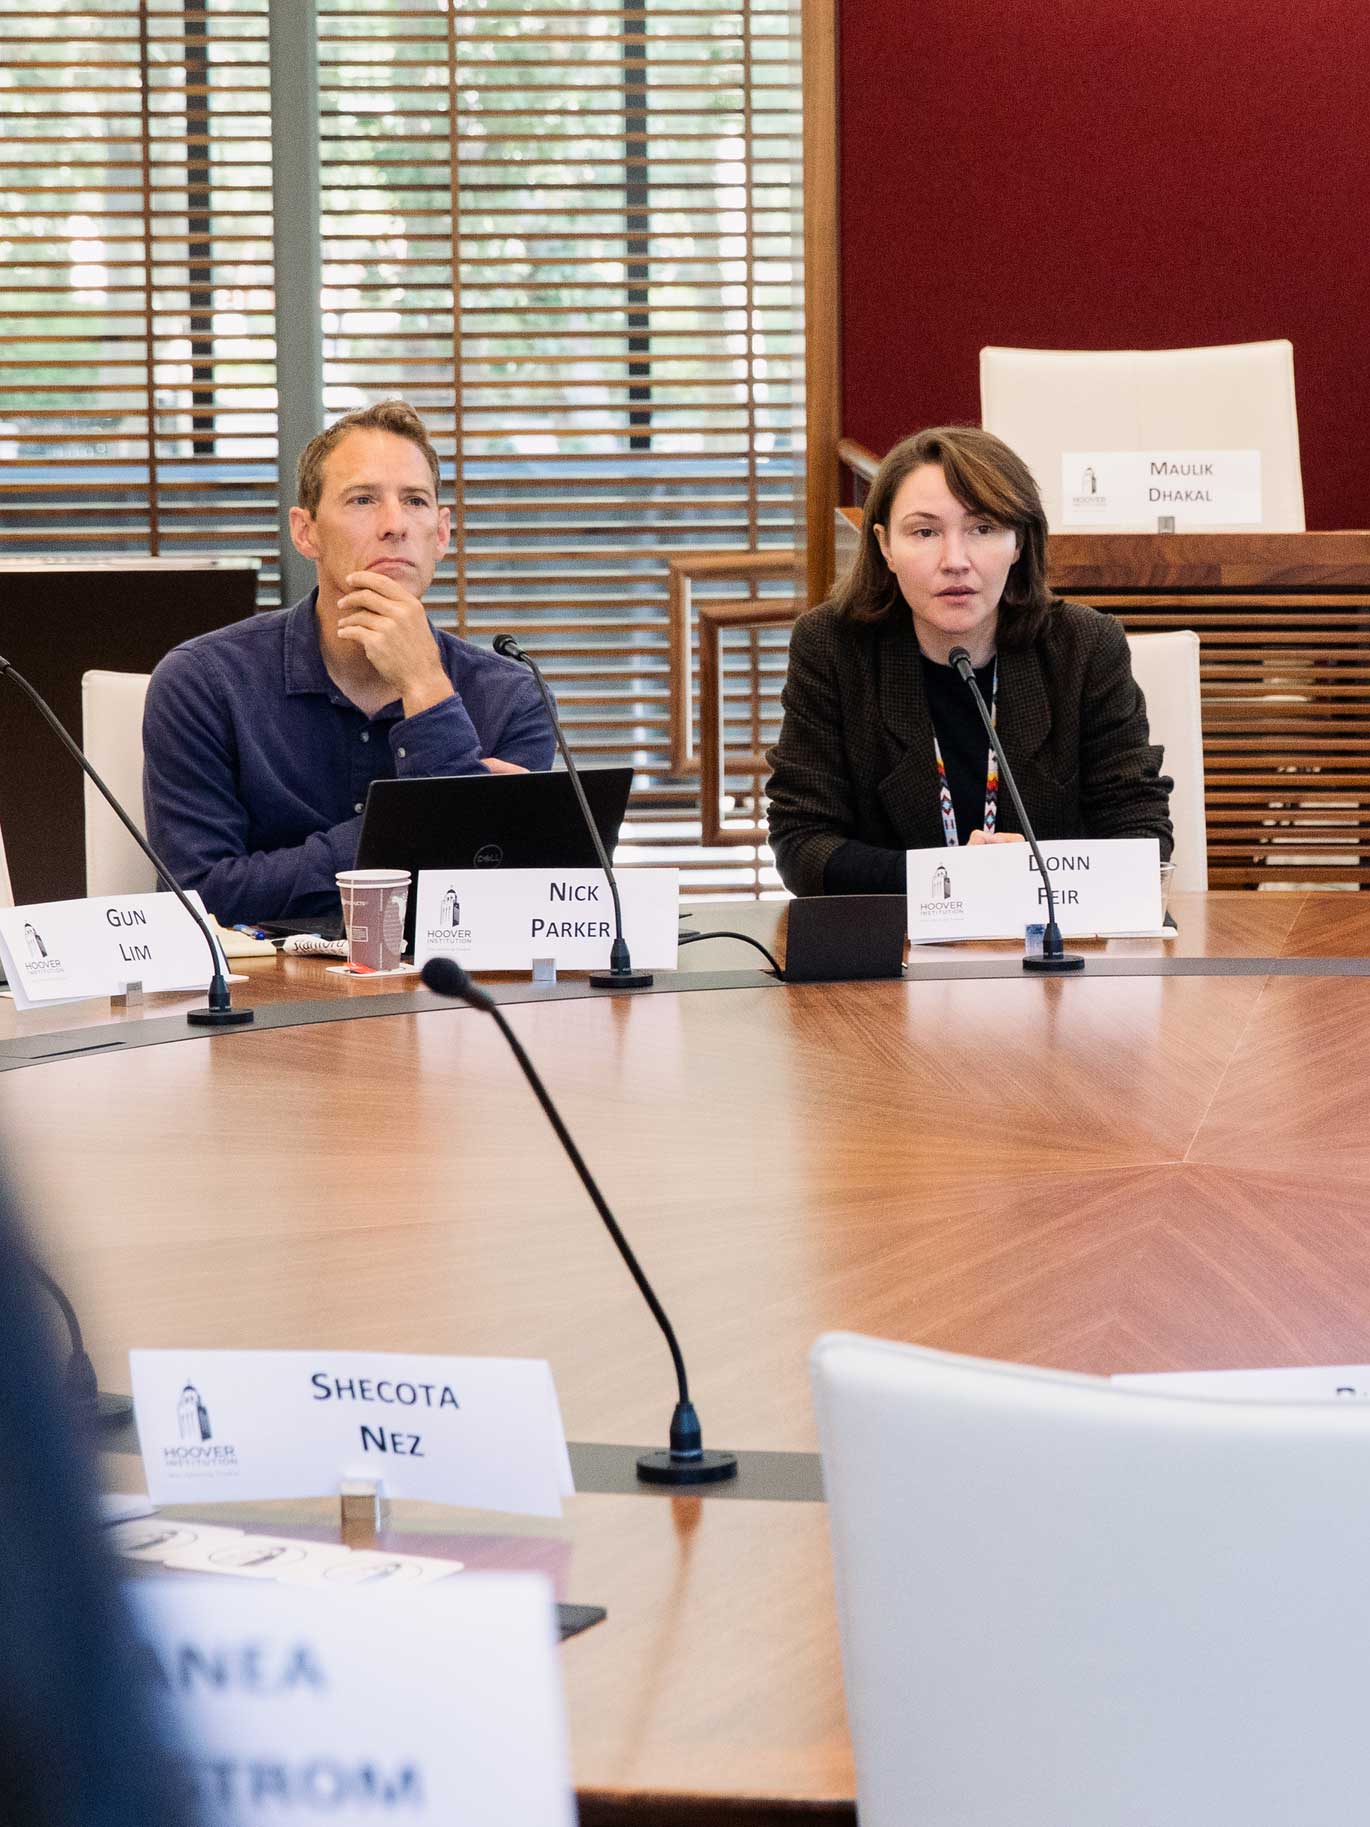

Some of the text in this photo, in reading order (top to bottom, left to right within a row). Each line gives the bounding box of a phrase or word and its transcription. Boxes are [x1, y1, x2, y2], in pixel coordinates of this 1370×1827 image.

[1150, 462, 1213, 476] MAULIK
[1149, 488, 1213, 502] DHAKAL
[550, 882, 599, 902] NICK
[920, 901, 963, 911] HOOVER
[106, 908, 147, 927] GUN
[427, 929, 472, 938] HOOVER
[531, 918, 611, 938] PARKER
[119, 943, 152, 962] LIM
[311, 1373, 460, 1410] SHECOTA
[360, 1425, 425, 1458] NEZ
[164, 1446, 236, 1458] HOOVER
